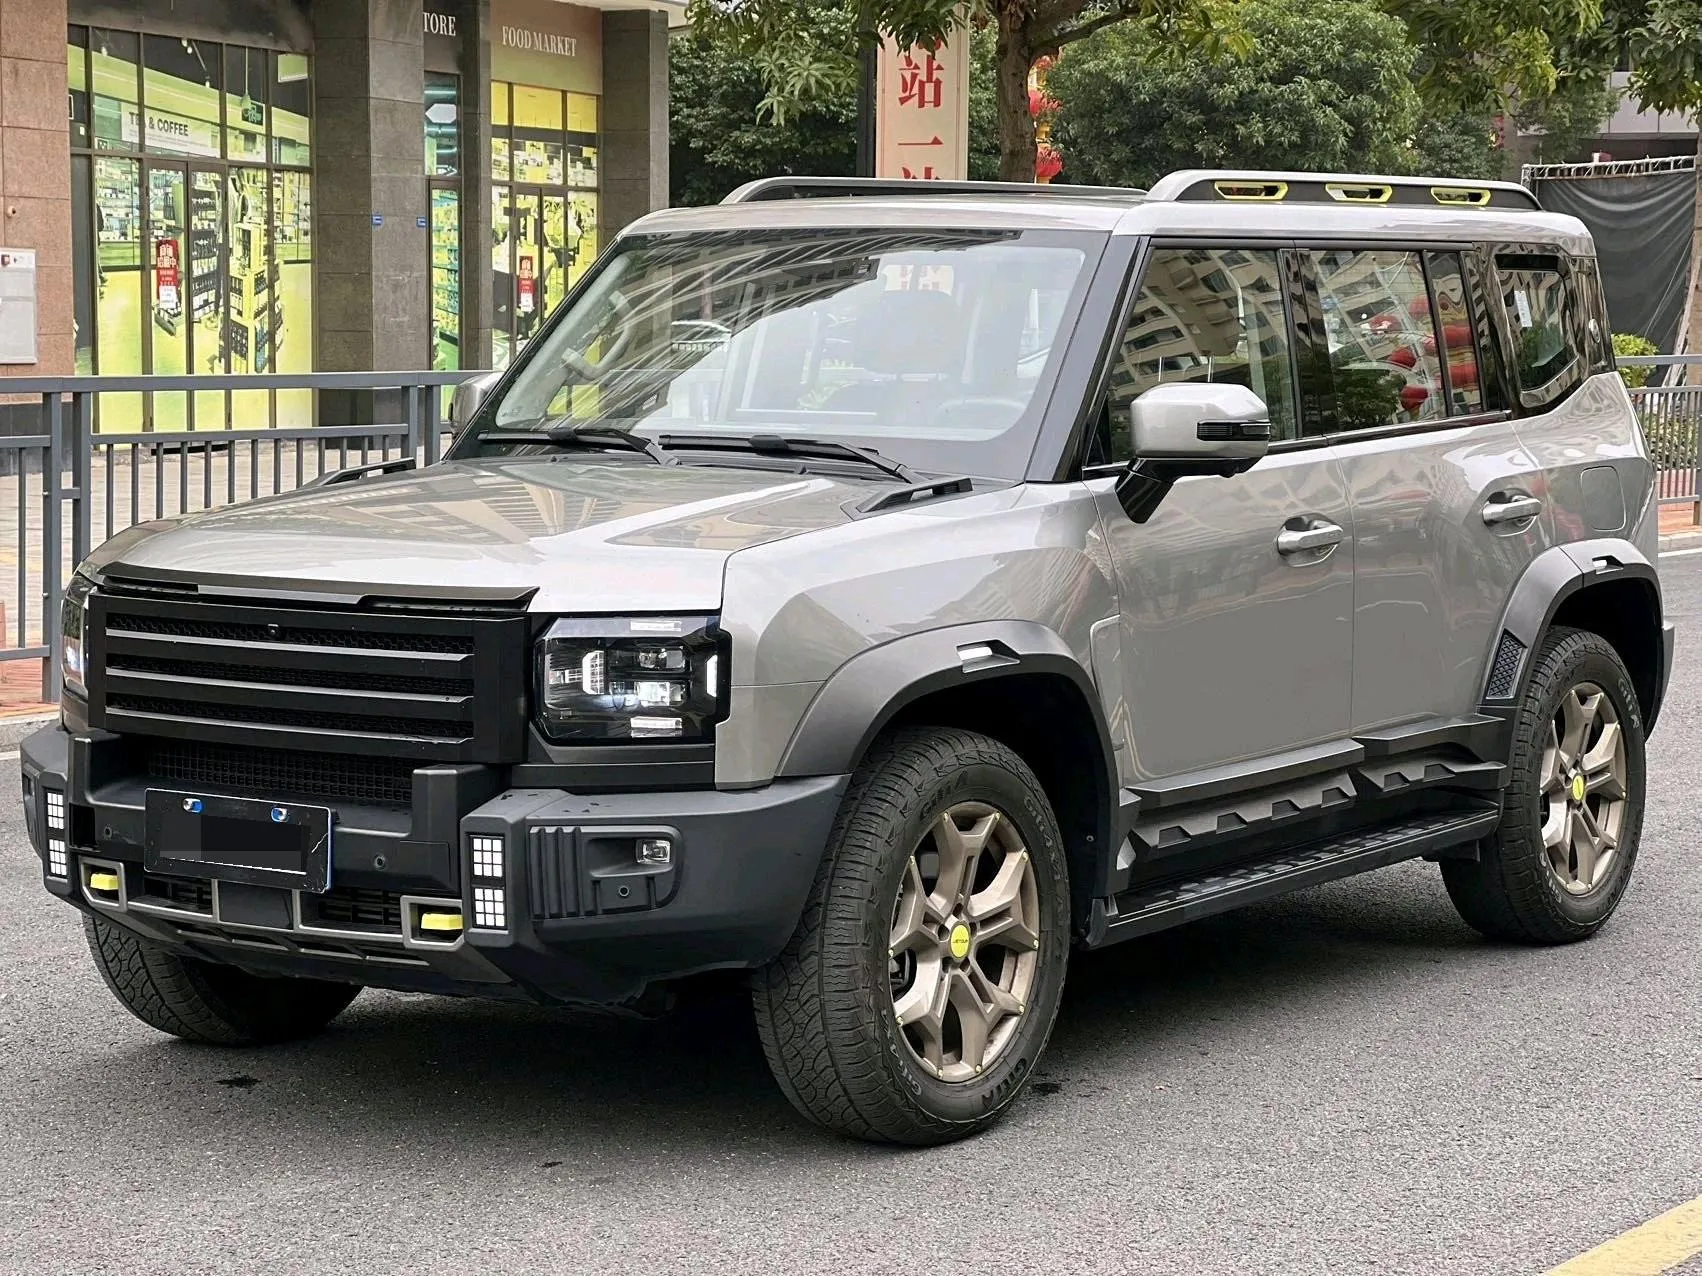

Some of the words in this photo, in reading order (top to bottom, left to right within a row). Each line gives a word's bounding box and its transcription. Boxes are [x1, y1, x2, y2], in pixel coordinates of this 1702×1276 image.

[423, 11, 456, 36] TORE
[502, 26, 531, 49] FOOD
[533, 32, 577, 57] MARKET
[898, 36, 945, 179] 站一
[129, 111, 145, 127] TE
[149, 116, 155, 129] &
[157, 118, 189, 137] COFFEE
